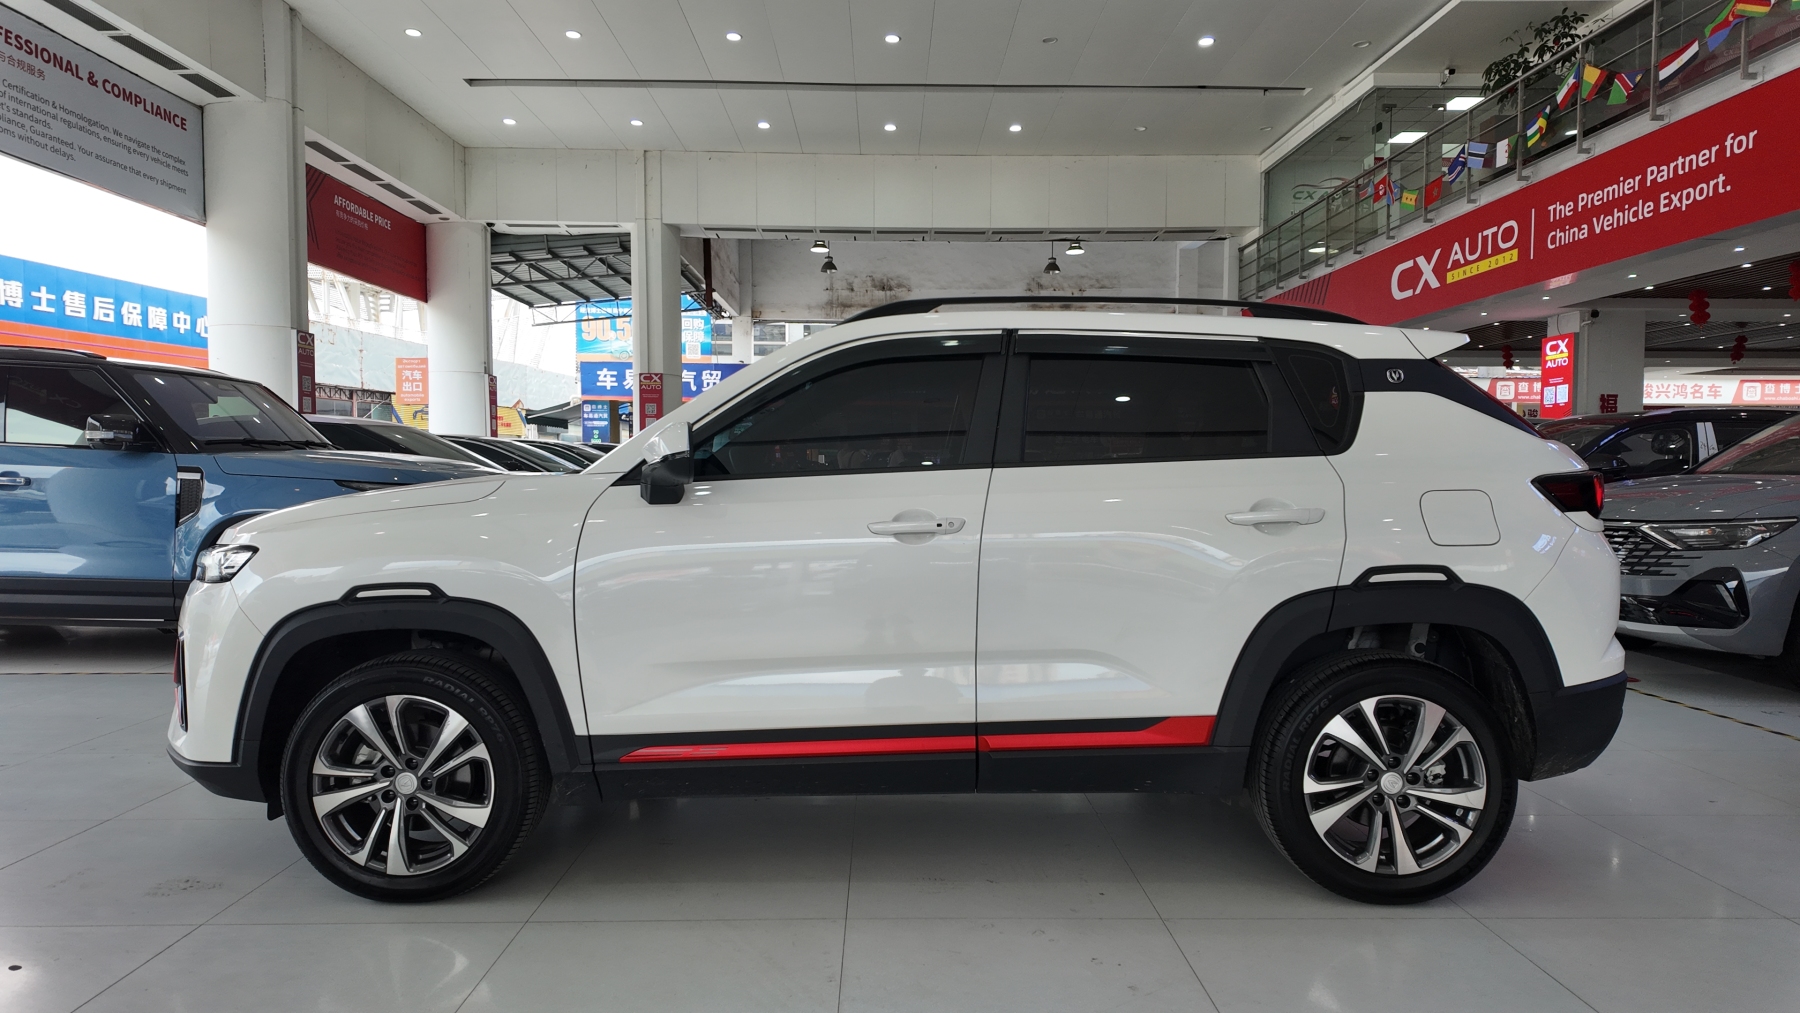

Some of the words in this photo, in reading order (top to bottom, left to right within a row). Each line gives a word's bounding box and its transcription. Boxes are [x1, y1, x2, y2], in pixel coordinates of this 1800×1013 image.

[87, 71, 98, 88] &
[102, 78, 187, 132] COMPLIANCE
[2, 78, 50, 106] Certification
[51, 100, 57, 110] &
[59, 104, 111, 134] Homologation.
[112, 127, 123, 138] We
[124, 134, 150, 150] navigate
[151, 146, 161, 156] the
[12, 108, 53, 130] standards.
[8, 92, 58, 121] international
[60, 116, 102, 142] regulations,
[103, 134, 132, 154] ensuring
[133, 148, 150, 161] every
[150, 155, 171, 169] vehicle
[172, 164, 189, 177] meets
[17, 133, 48, 151] without
[50, 145, 76, 161] delays.
[30, 125, 76, 150] Guaranteed.
[77, 144, 94, 158] Your
[95, 153, 128, 171] assurance
[129, 166, 142, 177] that
[143, 172, 159, 185] every
[160, 178, 187, 194] shipment
[1547, 200, 1574, 223] The
[1578, 174, 1642, 212] Premier
[1646, 144, 1720, 187] Partner
[1724, 130, 1758, 158] for
[334, 194, 374, 222] AFFORDABLE
[375, 214, 392, 230] PRICE
[1547, 223, 1588, 250] China
[1592, 199, 1654, 234] Vehicle
[1659, 173, 1732, 212] Export.
[1391, 248, 1442, 300] CX
[1447, 220, 1518, 269] AUTO
[1452, 264, 1480, 280] SINCE
[1488, 253, 1514, 268] 2012
[298, 333, 314, 346] CX
[298, 348, 314, 356] AUTO
[1546, 338, 1569, 355] CX
[402, 370, 422, 380] 汽车
[1546, 358, 1568, 368] AUTO
[402, 382, 422, 392] 出口
[640, 374, 661, 382] CX
[423, 676, 475, 703] RADIAL
